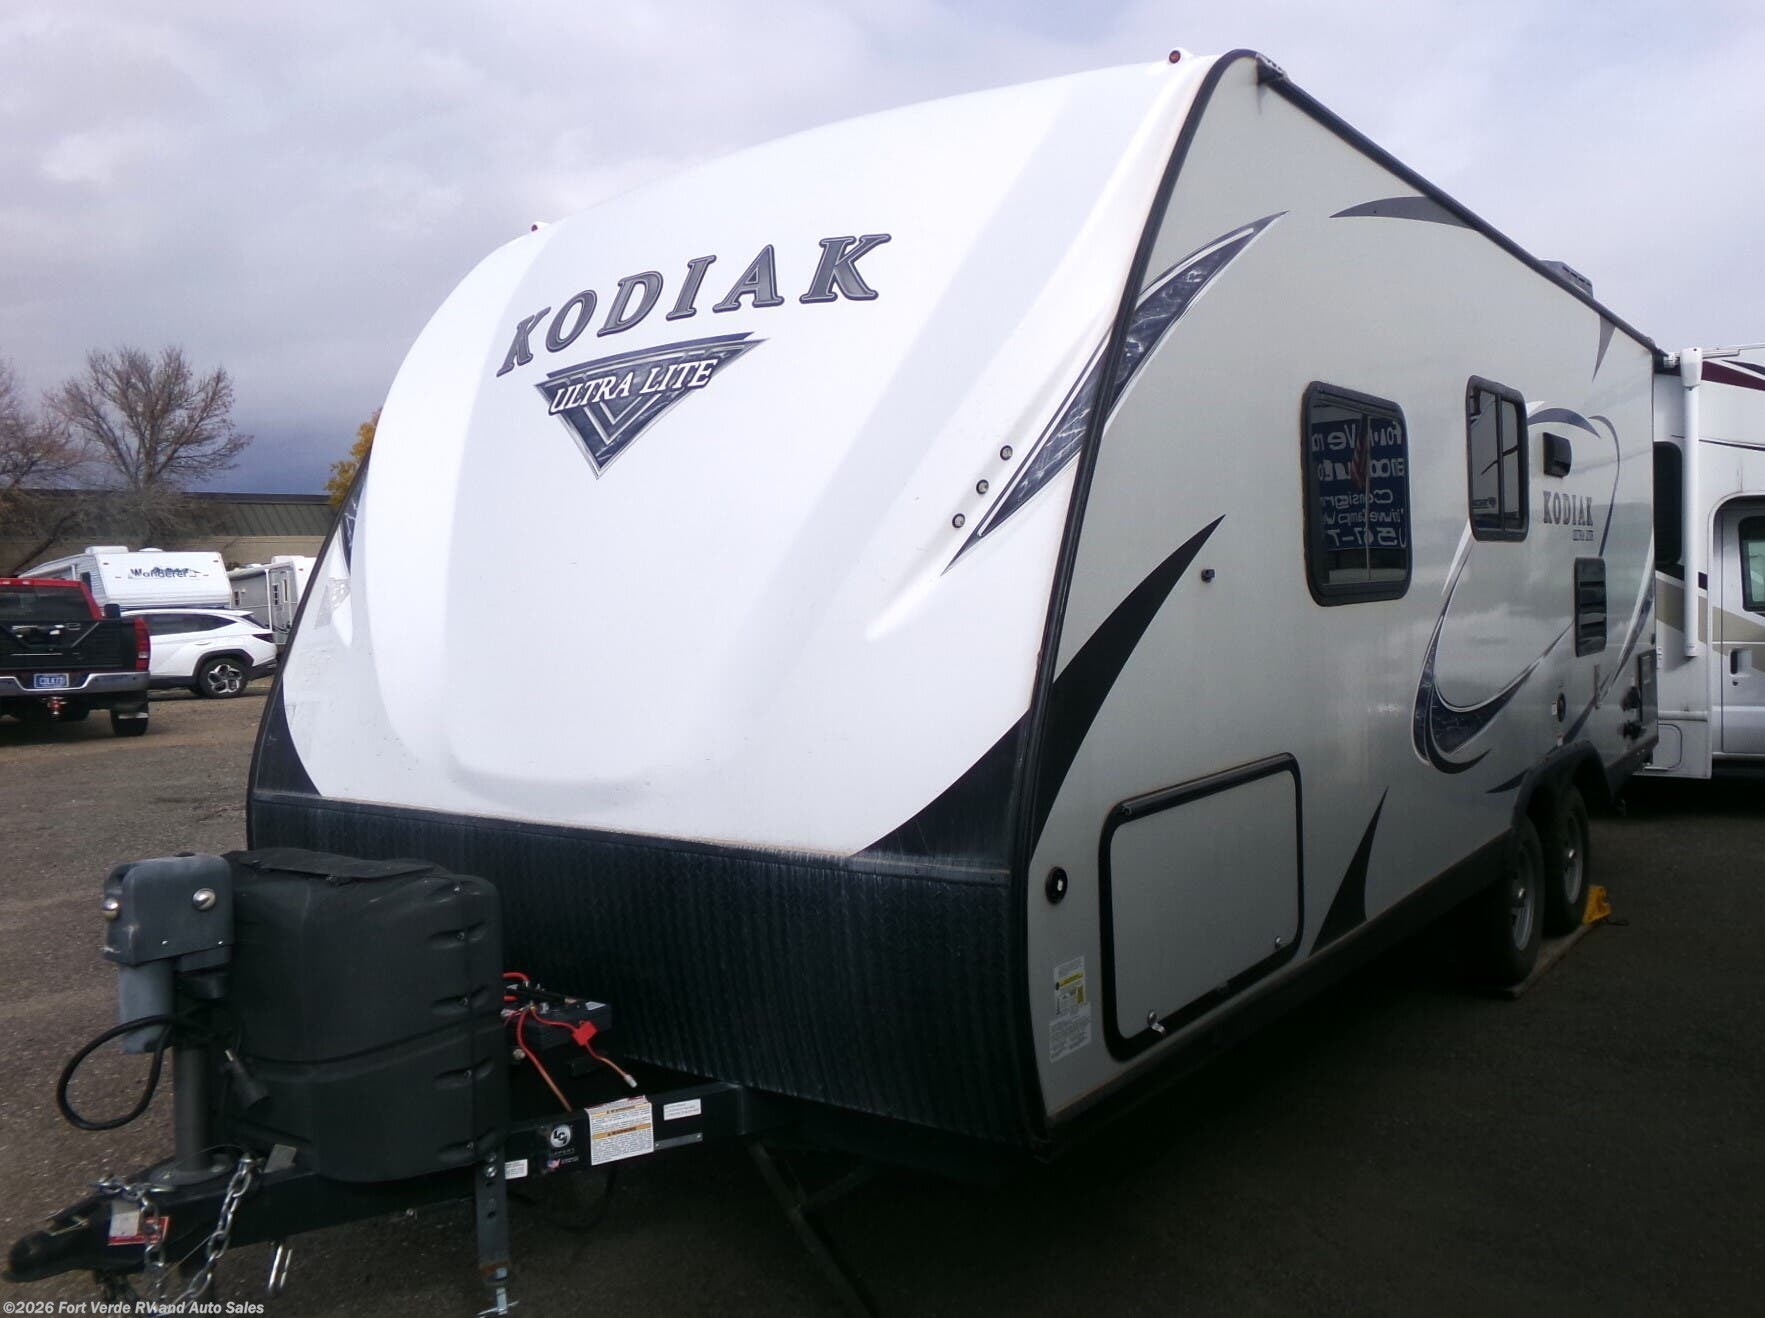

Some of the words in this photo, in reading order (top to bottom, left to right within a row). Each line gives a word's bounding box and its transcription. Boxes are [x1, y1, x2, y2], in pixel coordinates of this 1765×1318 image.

[496, 233, 892, 378] KODIAK
[549, 371, 635, 415] ULTRA
[639, 359, 719, 394] LITE
[1543, 490, 1593, 526] KODIAK
